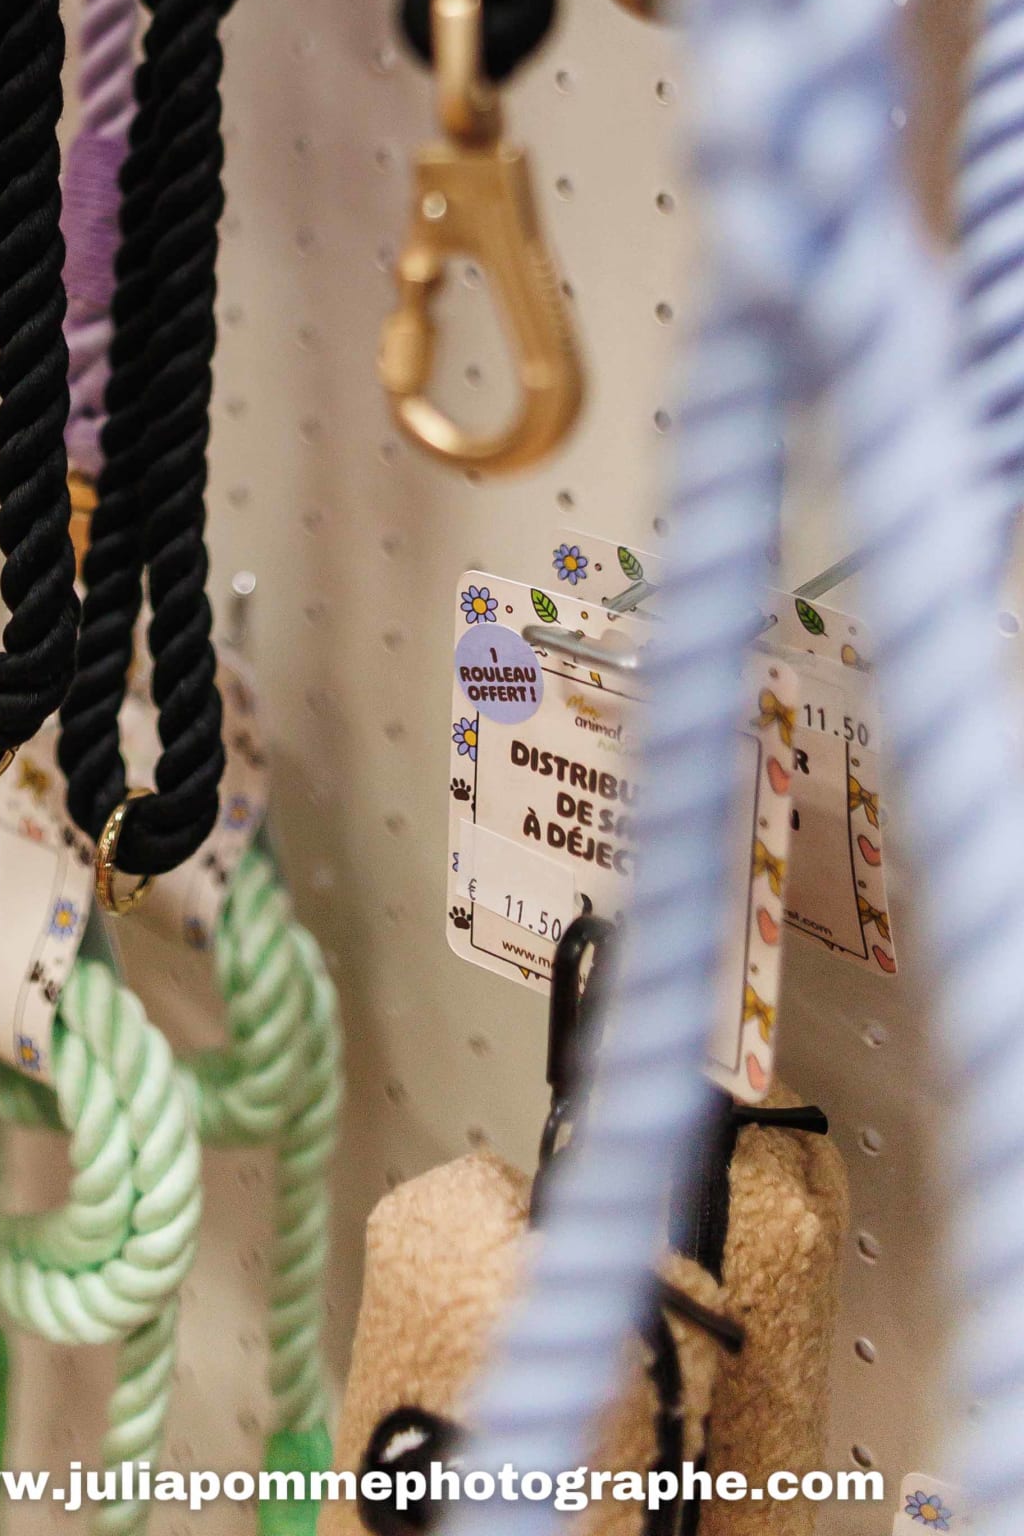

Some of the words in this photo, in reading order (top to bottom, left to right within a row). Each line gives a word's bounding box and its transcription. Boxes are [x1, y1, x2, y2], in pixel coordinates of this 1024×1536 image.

[460, 666, 536, 683] ROULEAU
[575, 716, 623, 744] animal
[803, 704, 868, 746] 11.50
[511, 740, 639, 806] DISTRIBU
[557, 792, 593, 827] DE
[598, 809, 634, 840] SA
[523, 806, 541, 841] À
[547, 822, 633, 876] DÉJEC
[505, 895, 562, 942] 11.50
